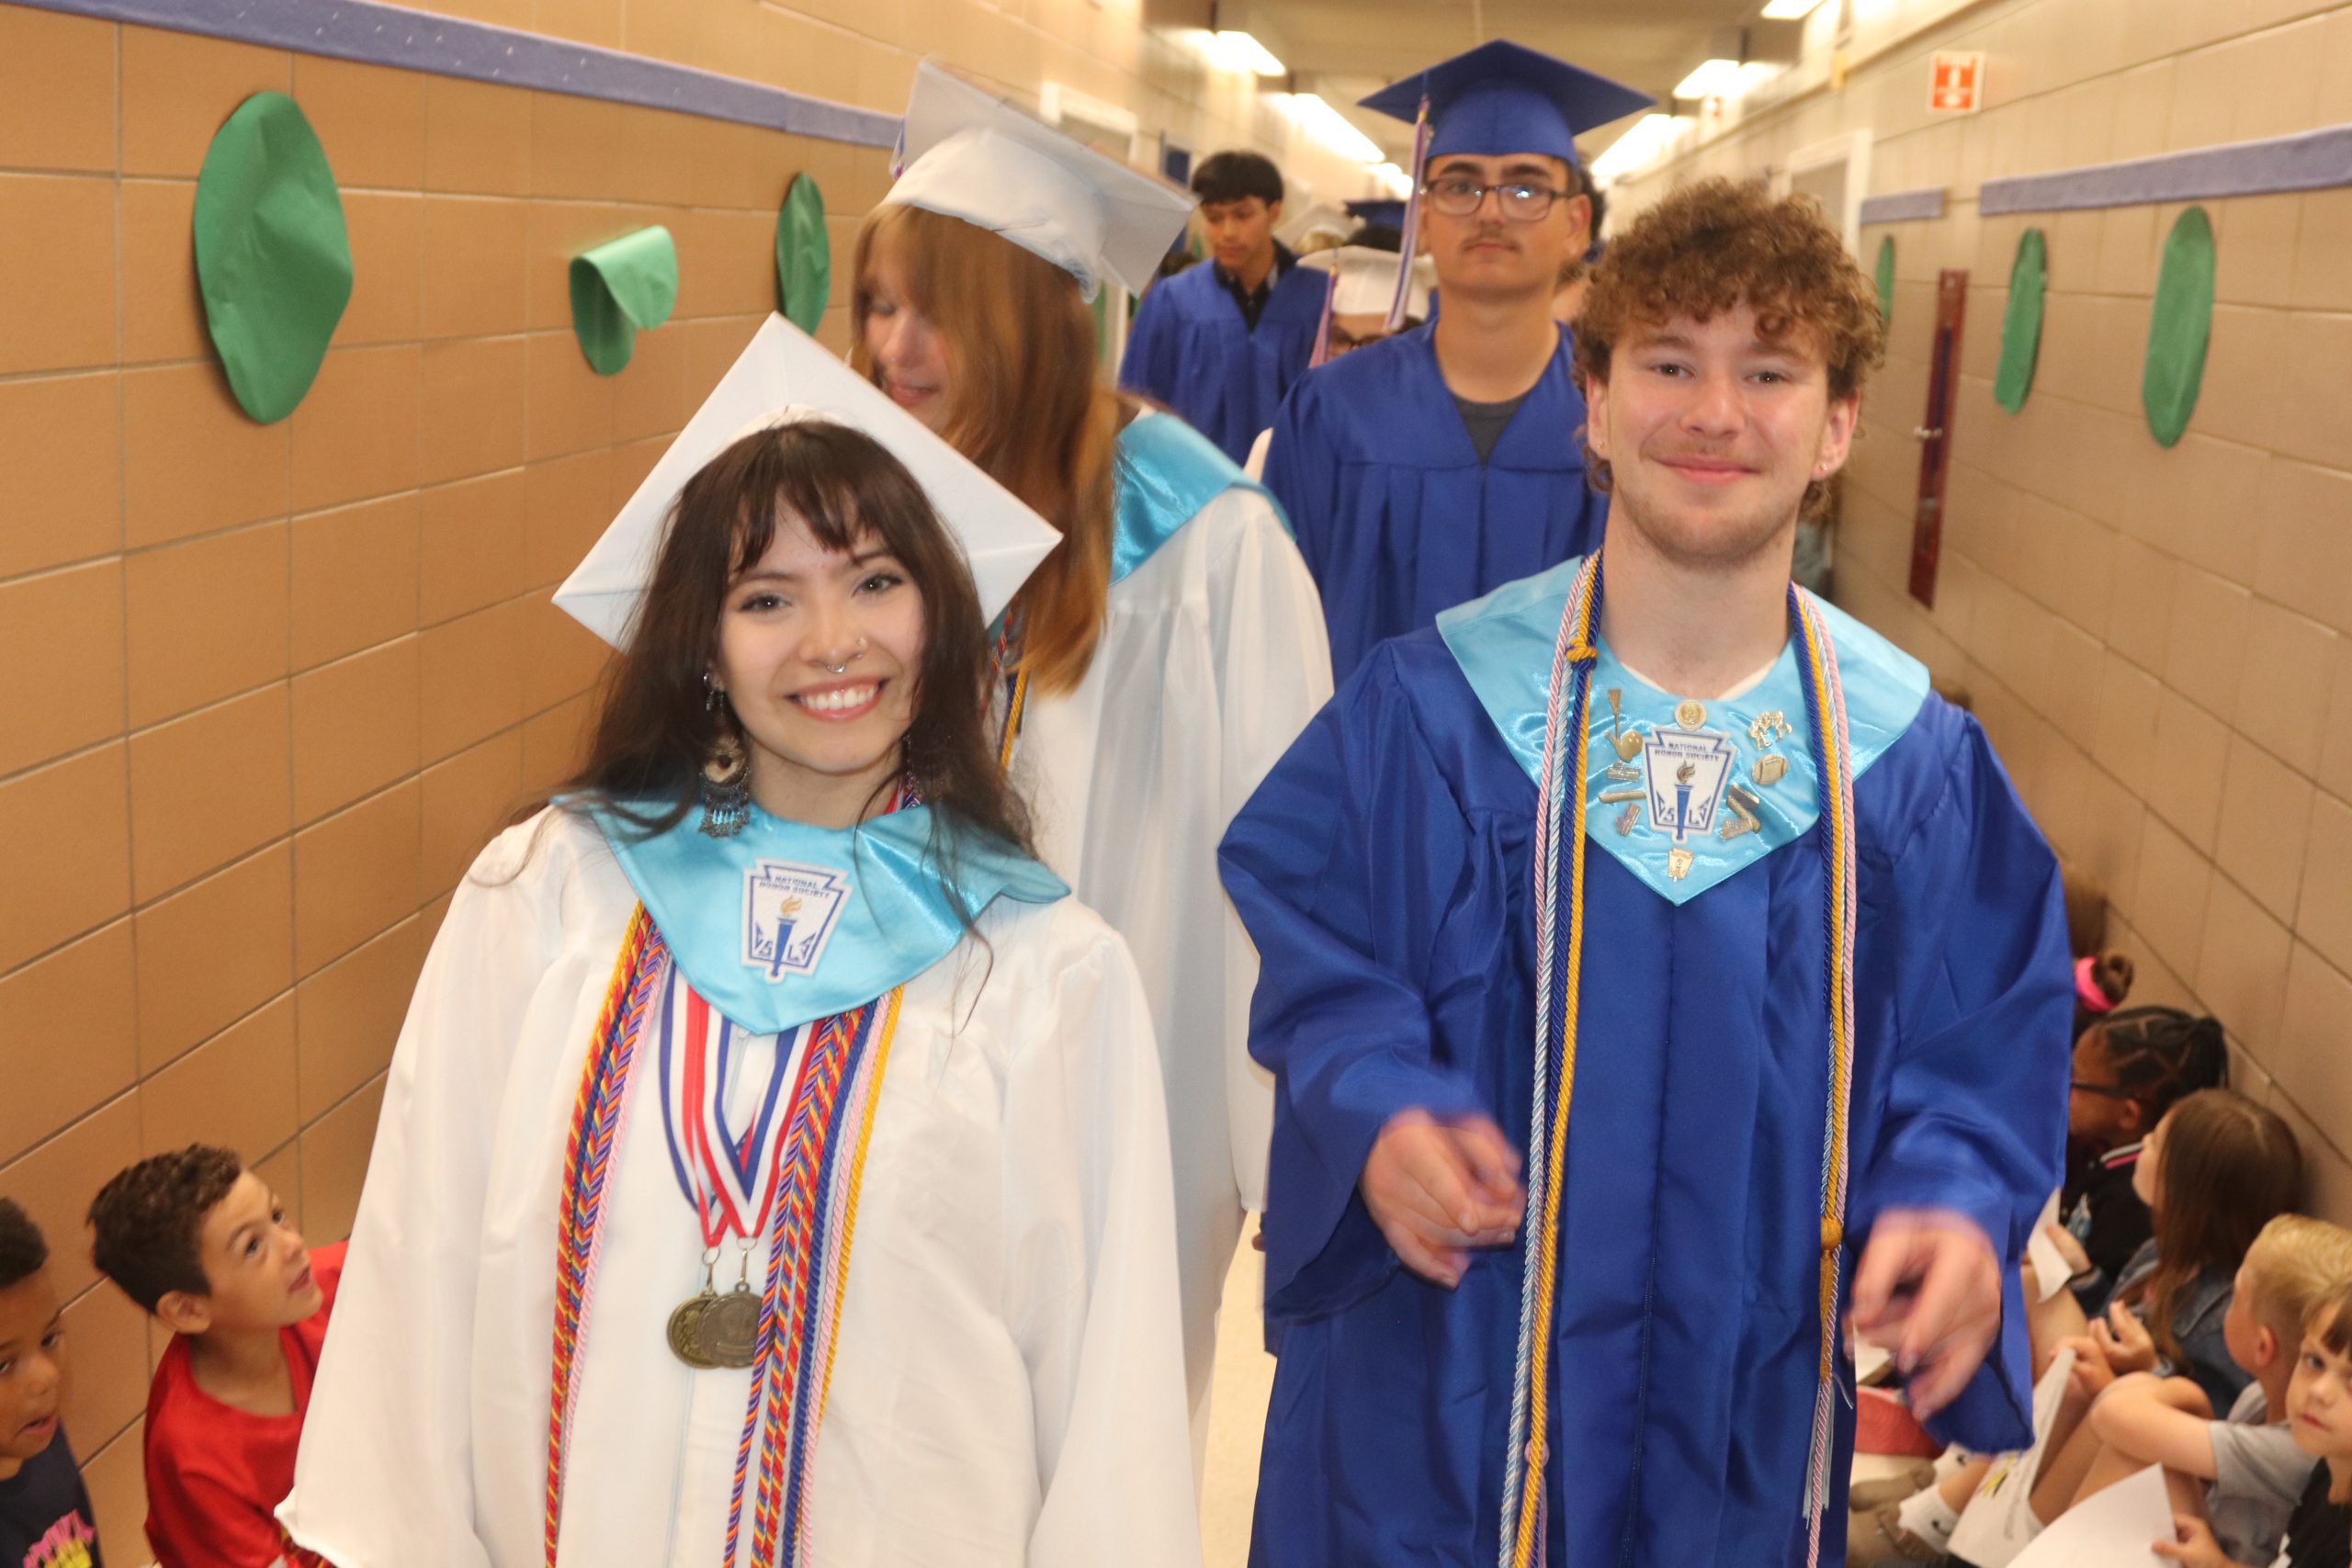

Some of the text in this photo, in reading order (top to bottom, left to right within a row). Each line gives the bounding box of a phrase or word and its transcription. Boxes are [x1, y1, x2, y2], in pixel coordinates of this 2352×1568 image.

[1668, 742, 1706, 751] NATIONAL
[1655, 750, 1719, 761] HONOR SOCIETY
[775, 875, 817, 889] NATIONAL
[759, 881, 830, 898] HONOR SOCIETY
